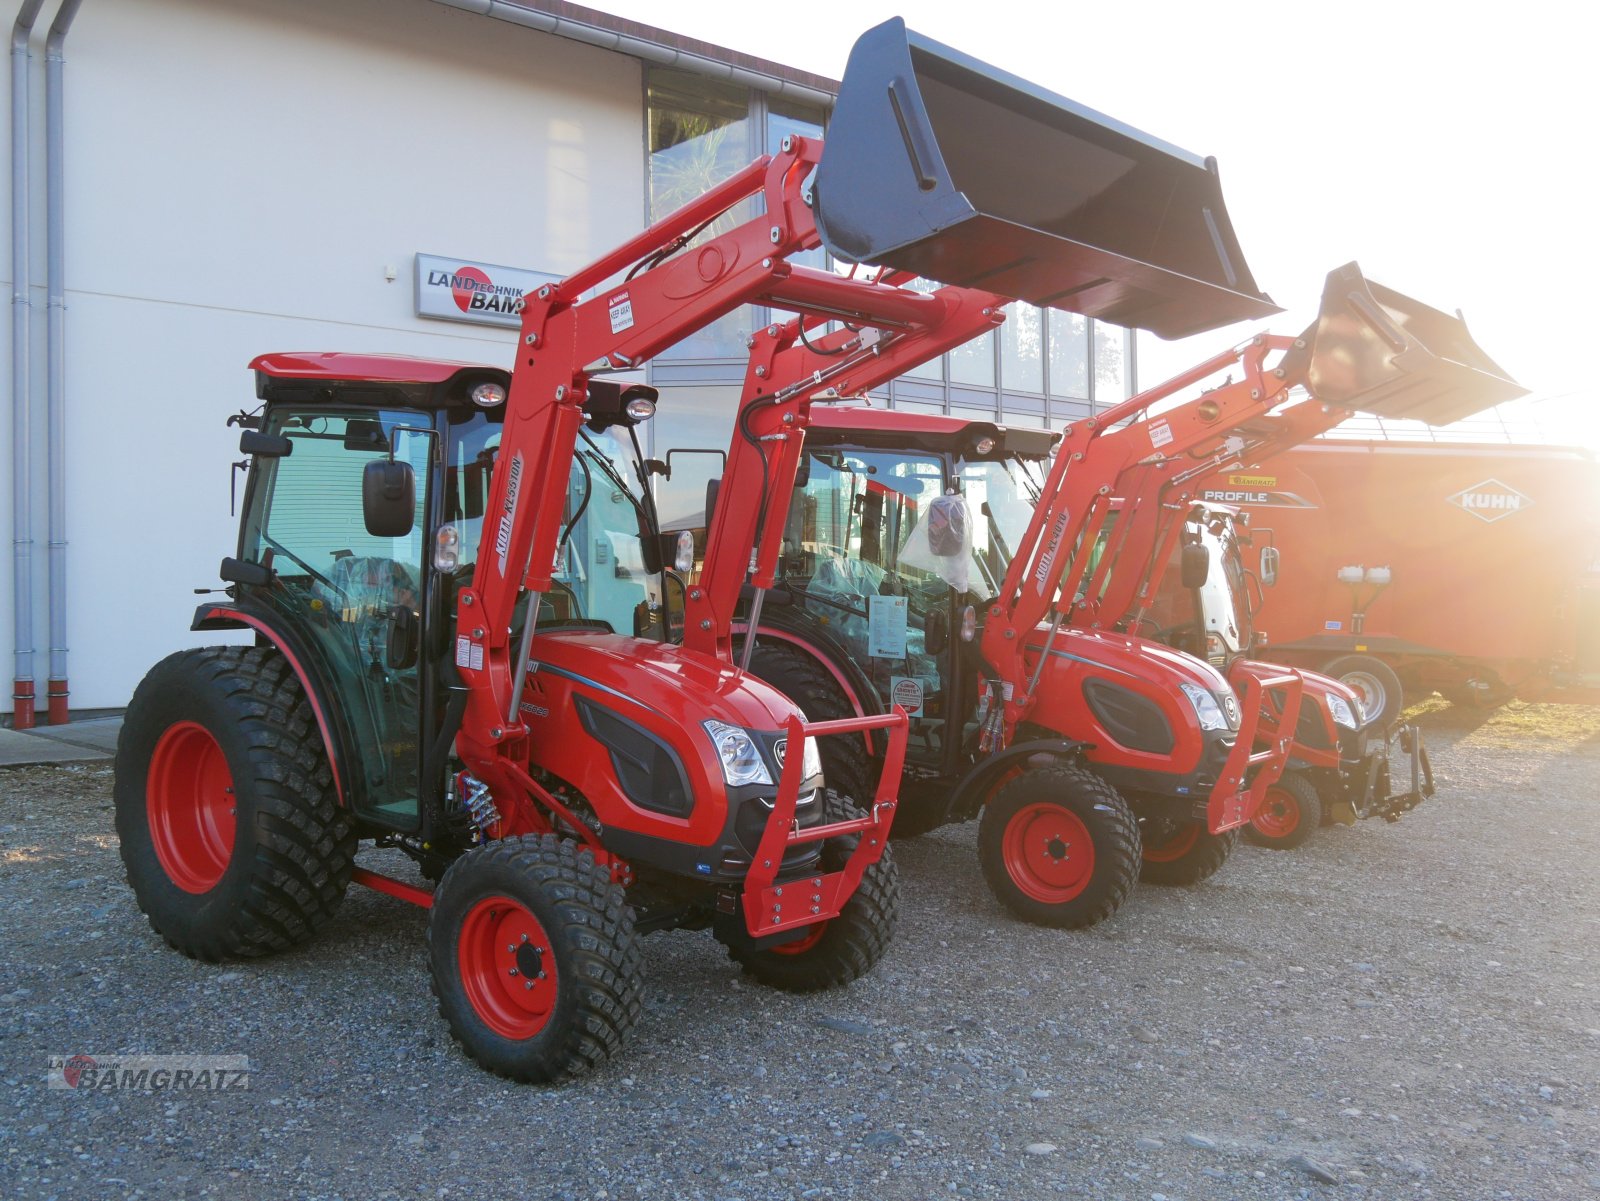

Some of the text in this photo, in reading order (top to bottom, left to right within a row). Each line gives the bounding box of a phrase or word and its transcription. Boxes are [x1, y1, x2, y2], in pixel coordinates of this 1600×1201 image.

[1204, 490, 1268, 502] PROFILE
[1462, 493, 1521, 509] KUHN
[495, 515, 511, 558] KIOTI
[1035, 552, 1053, 583] KIOTI
